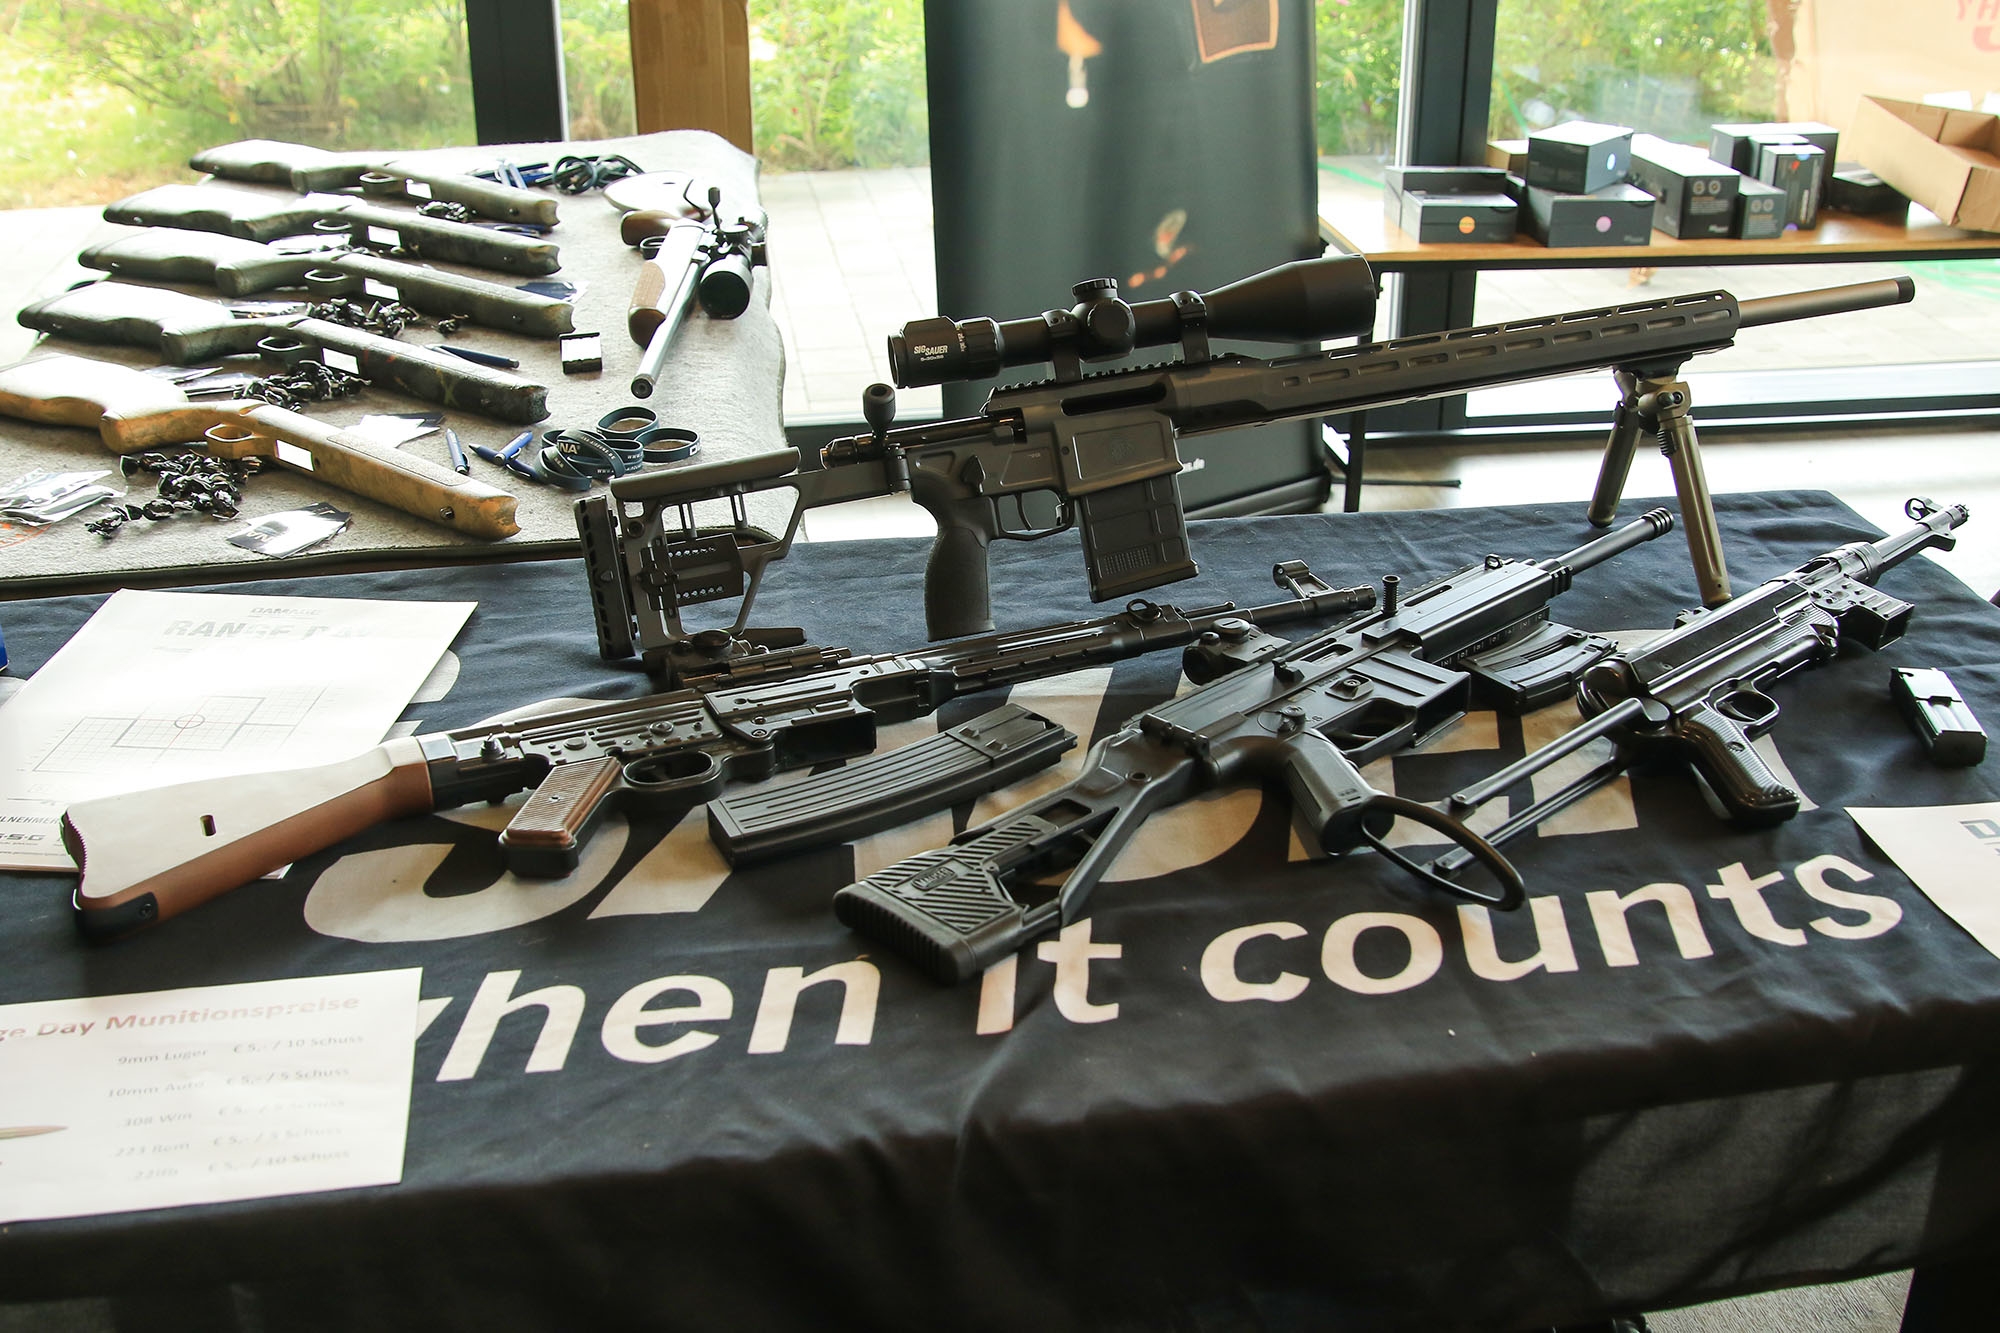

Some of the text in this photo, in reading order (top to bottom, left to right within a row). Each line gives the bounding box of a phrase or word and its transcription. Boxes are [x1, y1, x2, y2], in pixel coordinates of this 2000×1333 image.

[914, 345, 948, 356] SIG SAUER
[416, 960, 881, 1081] hen
[1201, 855, 1903, 1002] counts
[37, 1020, 95, 1036] Day
[105, 996, 361, 1032] Munitionspreise
